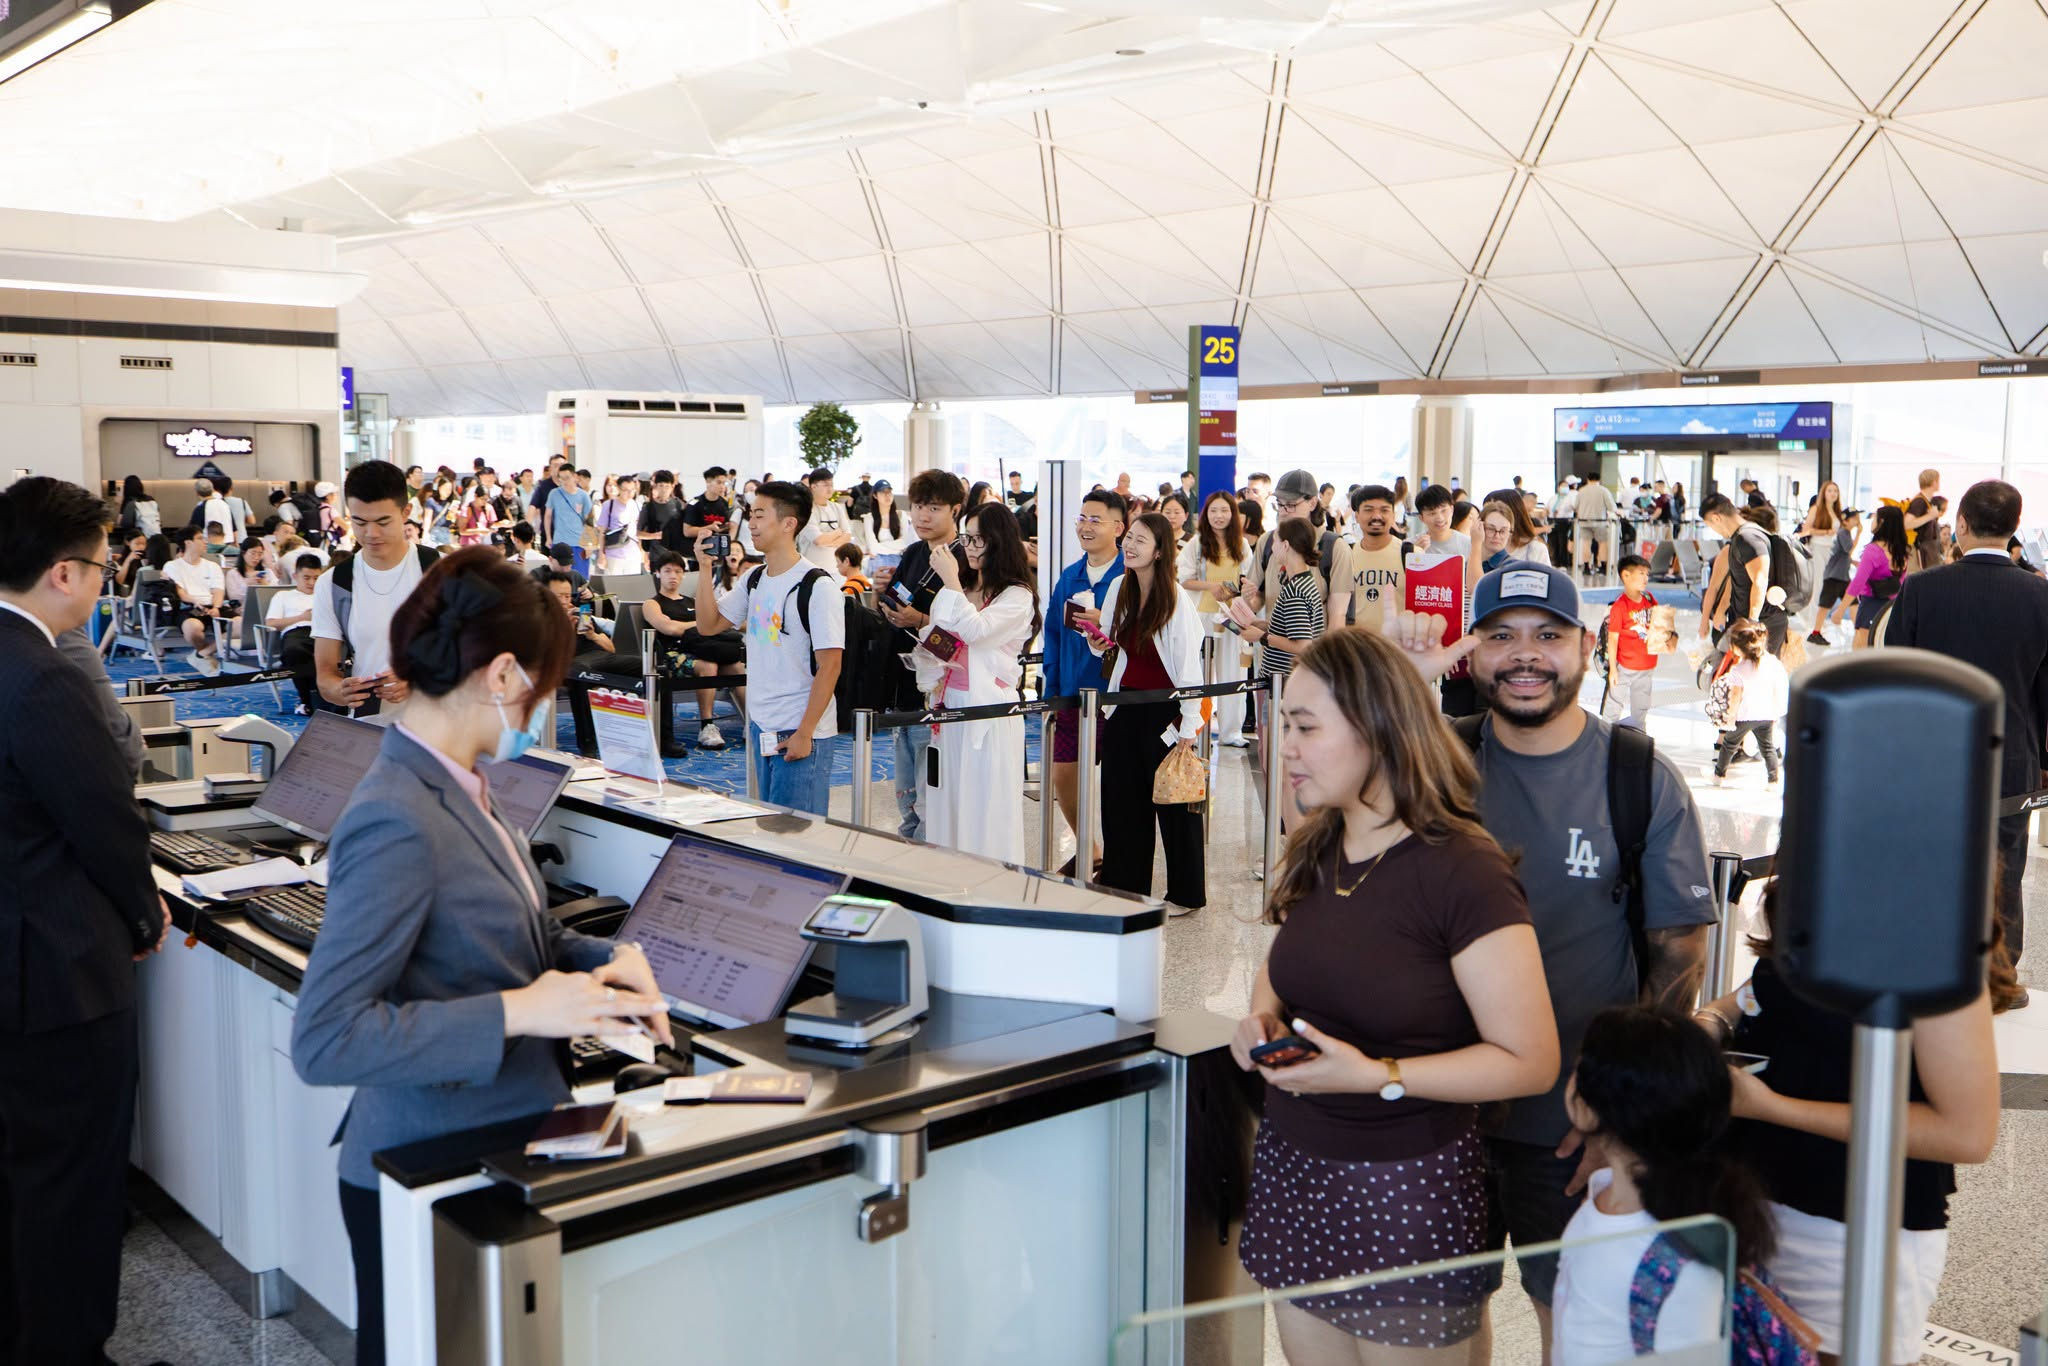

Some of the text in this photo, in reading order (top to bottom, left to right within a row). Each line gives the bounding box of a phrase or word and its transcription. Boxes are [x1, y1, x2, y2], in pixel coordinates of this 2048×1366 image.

[1204, 336, 1235, 364] 25
[1981, 365, 2012, 374] Economy
[1595, 415, 1607, 424] CA
[1752, 418, 1776, 428] 13:20
[1353, 570, 1399, 588] MOIN
[1415, 585, 1453, 602] 經濟艙
[1565, 828, 1600, 878] LA
